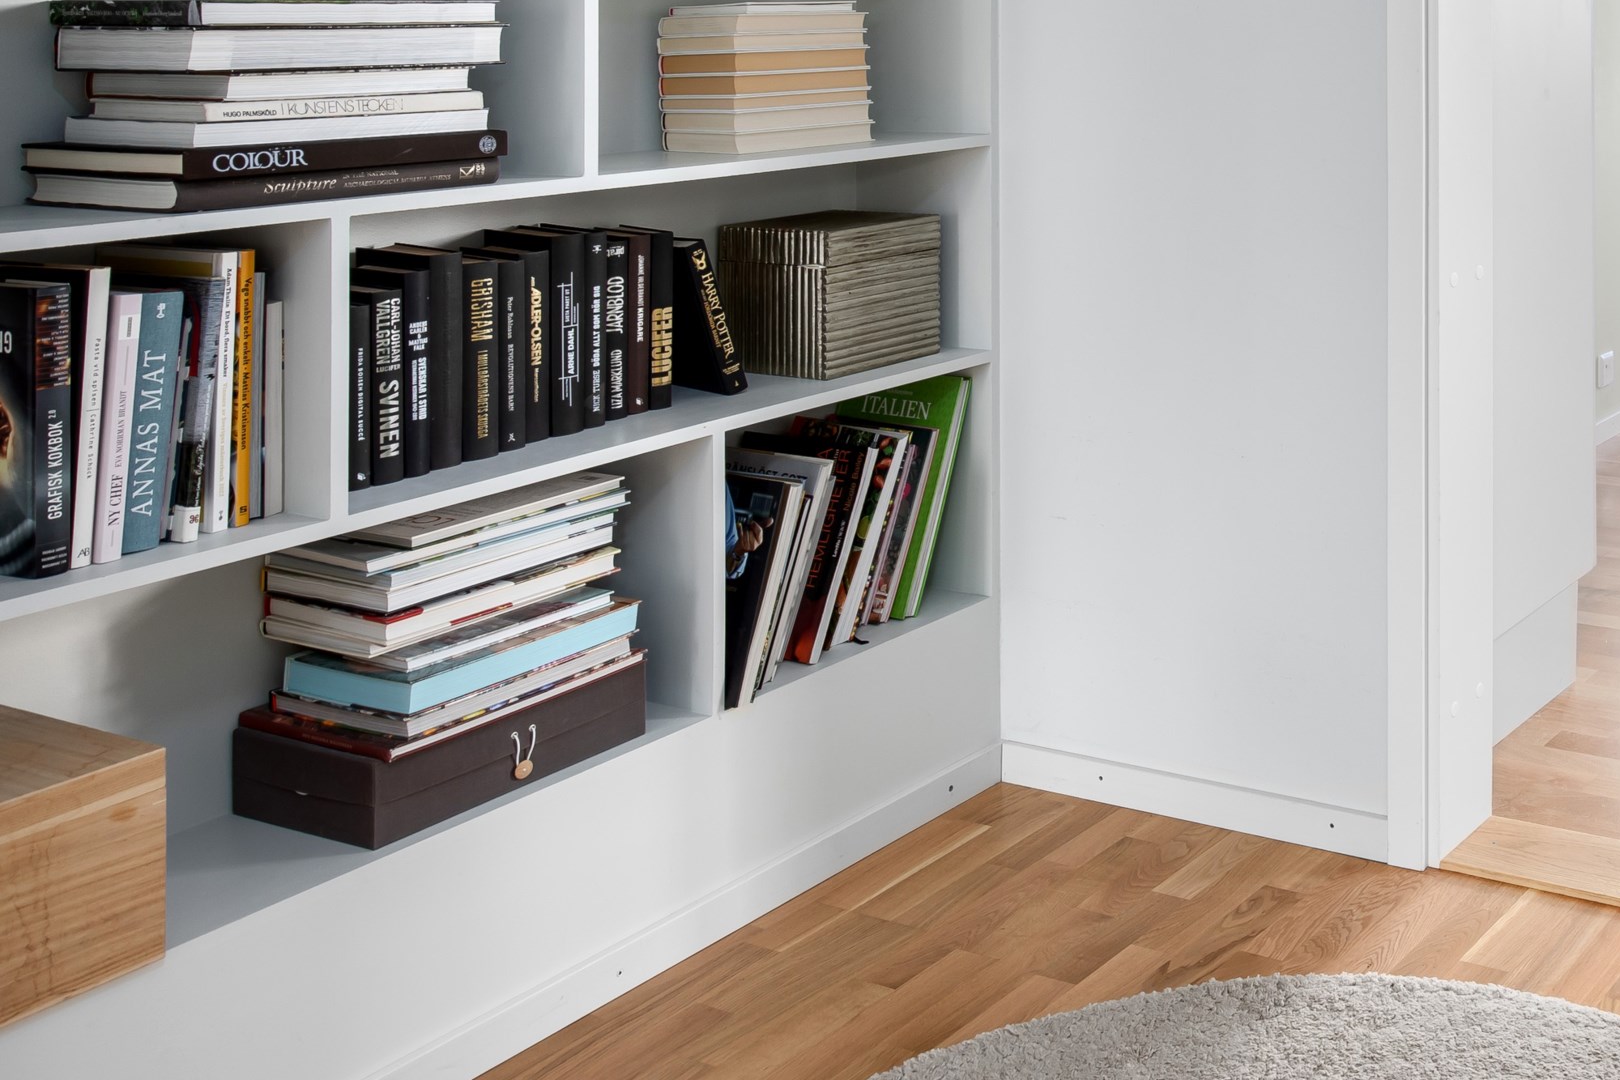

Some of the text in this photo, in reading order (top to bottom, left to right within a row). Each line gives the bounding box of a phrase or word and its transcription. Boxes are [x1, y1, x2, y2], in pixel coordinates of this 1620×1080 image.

[287, 98, 355, 115] KUNSTENS
[212, 148, 308, 172] COLOUR
[264, 178, 337, 197] Sculpture
[241, 277, 252, 296] Vego
[243, 299, 252, 323] snabbt
[471, 277, 493, 342] GRISHAM
[701, 272, 723, 311] HARRY
[714, 308, 735, 360] POTTER
[243, 326, 251, 339] och
[376, 299, 390, 365] VALLGREN
[390, 298, 400, 363] CARL-JOHAN
[531, 288, 541, 366] ADLER-OLSEN
[567, 328, 575, 351] DAHL
[593, 331, 601, 347] ALLT
[94, 338, 102, 360] Pasta
[651, 306, 672, 387] LUCIFER
[376, 364, 400, 373] LUCIFER
[418, 357, 427, 393] SVENSKAR
[610, 349, 623, 409] LIZA MARKLUND
[242, 372, 250, 401] Mattias
[118, 390, 127, 418] BRANDT
[418, 399, 427, 420] STRID
[592, 395, 601, 412] NICK
[861, 394, 932, 420] ITALIEN
[241, 403, 250, 450] Kristiansson
[379, 380, 400, 458] SVINEN
[477, 414, 489, 439] SKUGGA
[48, 420, 63, 468] KOKBOK
[131, 350, 167, 517] ANNAS MAT
[114, 455, 122, 469] EVA
[48, 470, 63, 520] GRAFISK
[110, 474, 124, 507] CHEF
[108, 510, 120, 527] NY
[806, 449, 852, 588] HEMLIGHETER
